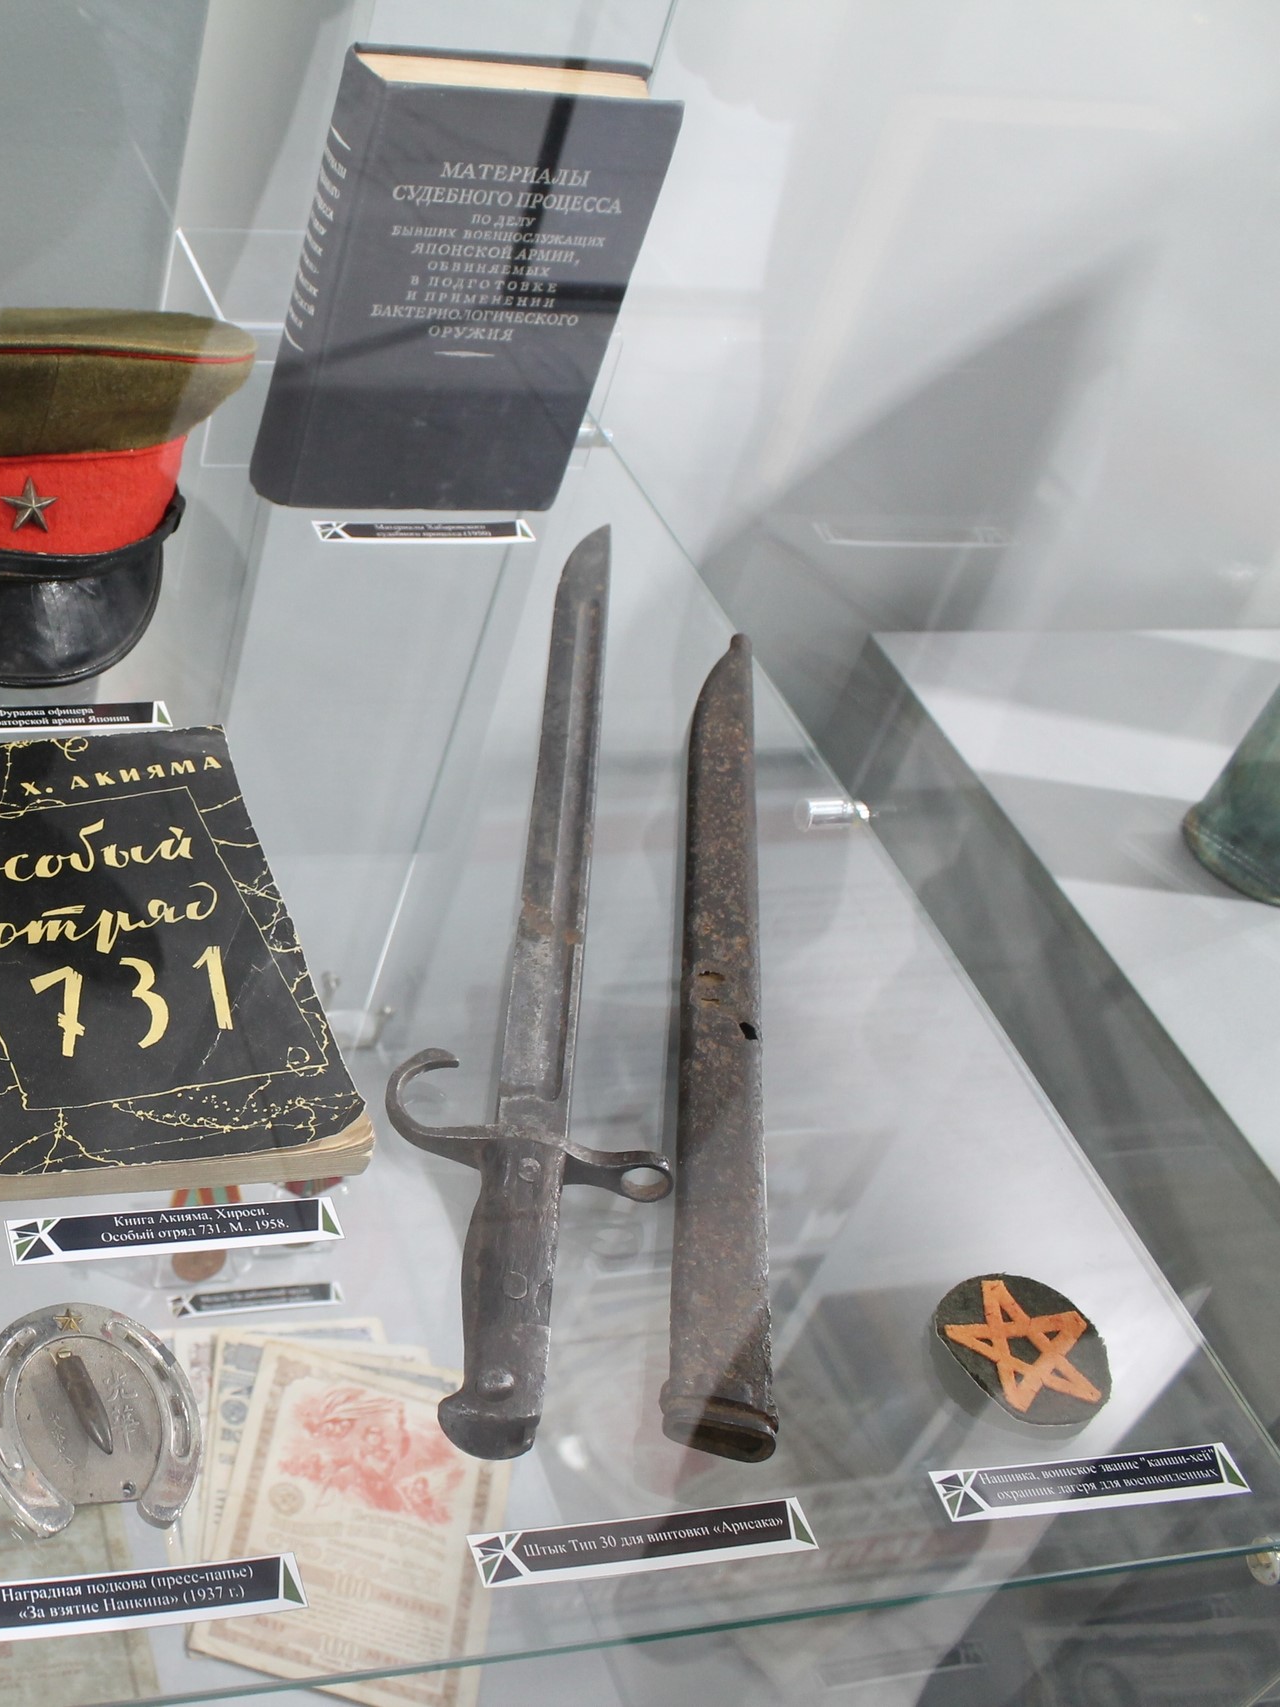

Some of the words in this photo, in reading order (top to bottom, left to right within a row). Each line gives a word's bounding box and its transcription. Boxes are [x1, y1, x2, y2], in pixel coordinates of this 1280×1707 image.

[441, 161, 591, 187] МАТЕРИАЛЫ
[392, 184, 513, 208] СУДЕБНОГО
[517, 192, 622, 216] ПРОЦЕССА
[471, 213, 492, 226] ПО
[493, 214, 536, 229] ДЕЛУ
[391, 225, 457, 238] БЫВШИХ
[463, 229, 607, 248] ВОЕННОСЛУЖАЩИХ
[411, 242, 512, 260] ЯПОНСКОЙ
[515, 249, 580, 266] АРМИИ,
[428, 260, 552, 278] ОБВИНЯЕМЫХ
[410, 275, 420, 286] В
[428, 276, 558, 294] ПОДГОТОВКЕ
[406, 290, 417, 301] И
[424, 291, 556, 309] ПРИМЕНЕНИИ
[370, 303, 579, 327] БАКТЕРИОЛОГИЧЕСКОГО
[428, 325, 515, 341] ОРУЖИЯ
[48, 706, 94, 717] офицера
[51, 716, 85, 725] армии
[88, 714, 130, 724] Японии
[21, 780, 54, 796] Х.
[70, 756, 223, 790] АКИЯМА
[29, 945, 233, 1058] 731
[114, 1213, 156, 1227] Книга
[215, 1207, 270, 1223] Хироси.
[101, 1227, 155, 1244] Особый
[158, 1226, 196, 1242] отряд
[199, 1222, 228, 1235] 731.
[254, 1217, 289, 1231] 1958.
[978, 1471, 1040, 1485] Нашивка,
[1041, 1465, 1097, 1479] воинское
[1099, 1461, 1139, 1473] звание
[997, 1486, 1055, 1501] охранник
[1058, 1481, 1097, 1494] лагеря
[1101, 1479, 1121, 1490] для
[1123, 1468, 1219, 1485] военнопленных
[523, 1542, 567, 1558] Штык
[568, 1537, 597, 1555] Тип
[601, 1535, 617, 1549] 30
[620, 1533, 644, 1548] для
[647, 1526, 710, 1544] винтовки
[713, 1515, 783, 1536] «Арисака»
[1, 1584, 82, 1603] Наградная
[86, 1580, 148, 1597] подкова
[150, 1565, 254, 1590] (пресс-папье)
[18, 1605, 46, 1621] «За
[50, 1602, 100, 1617] взятие
[104, 1594, 179, 1612] Нанкина»
[183, 1587, 223, 1606] (1937
[229, 1585, 246, 1600] г.)
